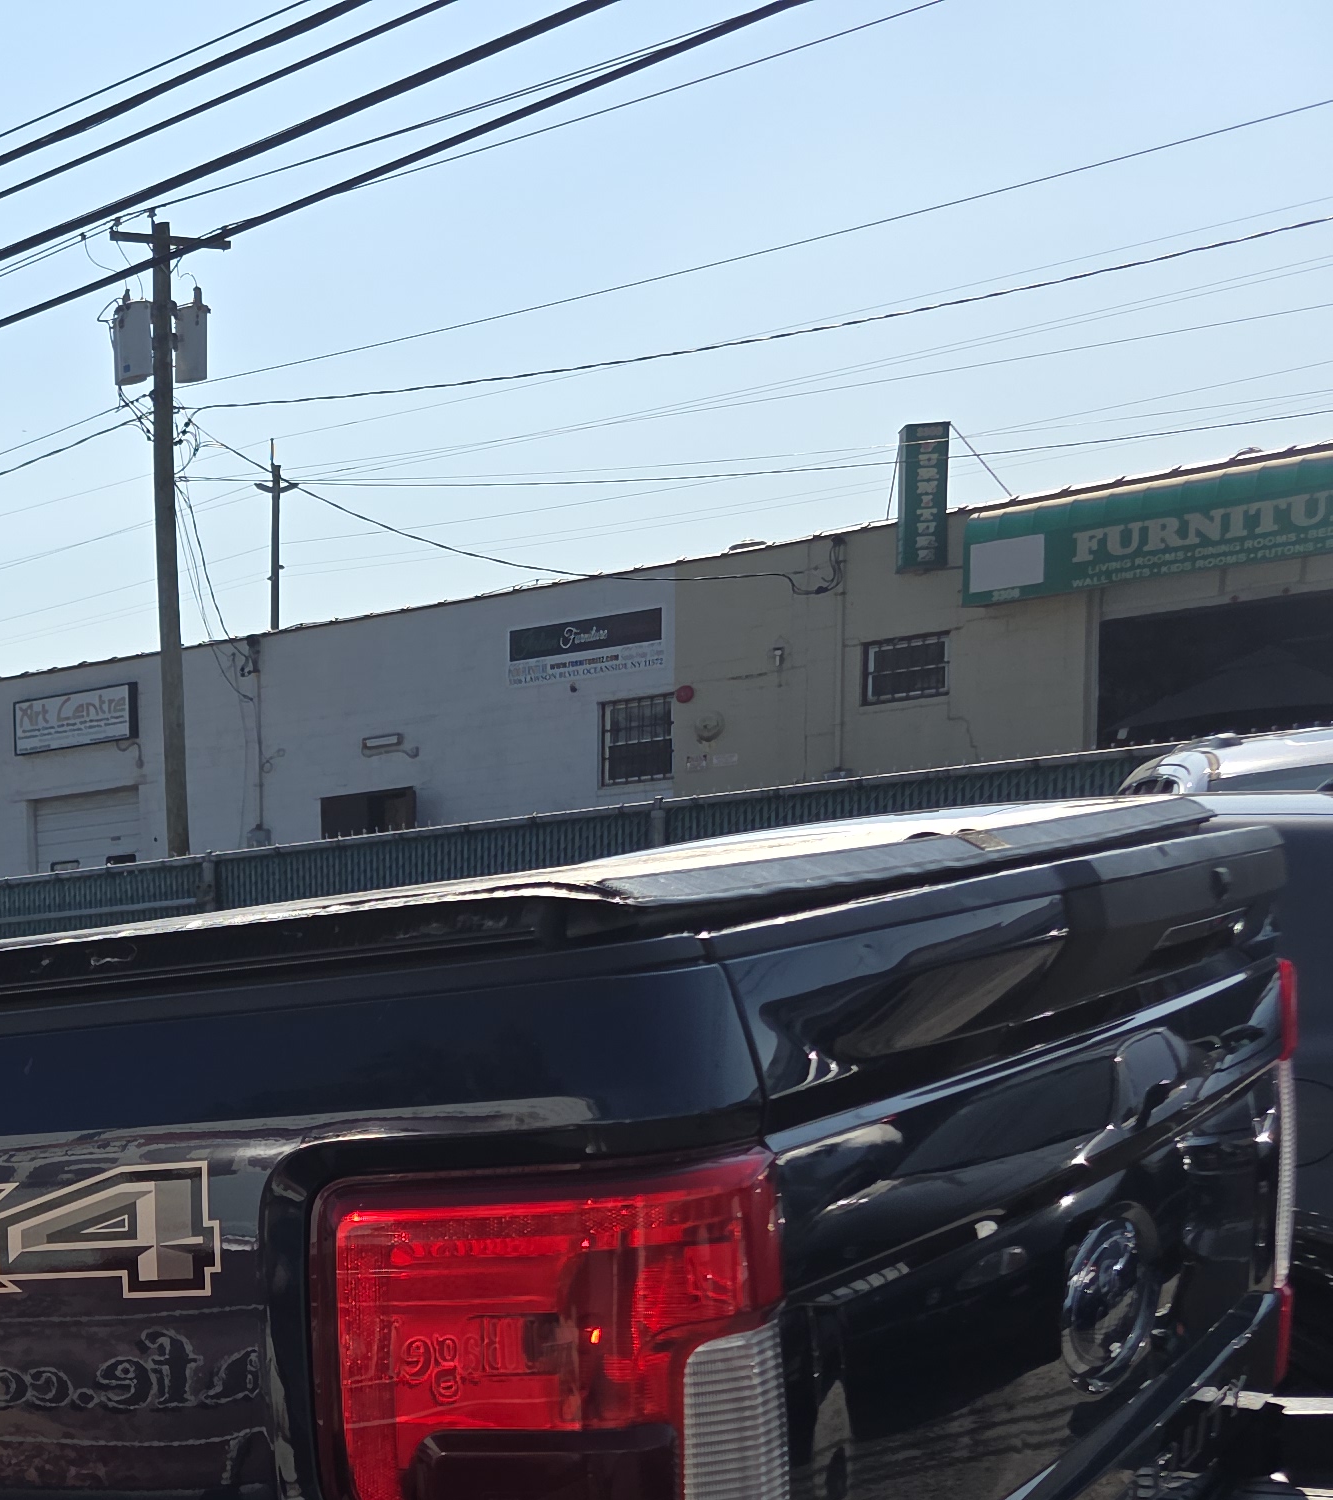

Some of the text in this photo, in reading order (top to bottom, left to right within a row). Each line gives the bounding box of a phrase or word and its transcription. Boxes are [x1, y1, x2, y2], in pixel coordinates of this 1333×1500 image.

[1071, 488, 1333, 563] FURNITU
[1072, 575, 1109, 588] WALL
[1111, 567, 1151, 582] UNITS
[1160, 559, 1192, 575] KIDS
[1195, 552, 1247, 568] ROOMS
[1256, 542, 1315, 559] FUTONS
[1087, 558, 1132, 575] LIVING
[1134, 550, 1186, 567] ROOMS
[1194, 541, 1241, 558] DINING
[1244, 532, 1297, 549] ROOMS
[559, 626, 608, 649] Furniture
[524, 670, 557, 685] LAWSON
[582, 661, 629, 677] OCEANSIDE
[630, 660, 642, 669] NY
[643, 657, 664, 667] 11572
[18, 703, 50, 728] Art
[56, 694, 127, 722] Centre
